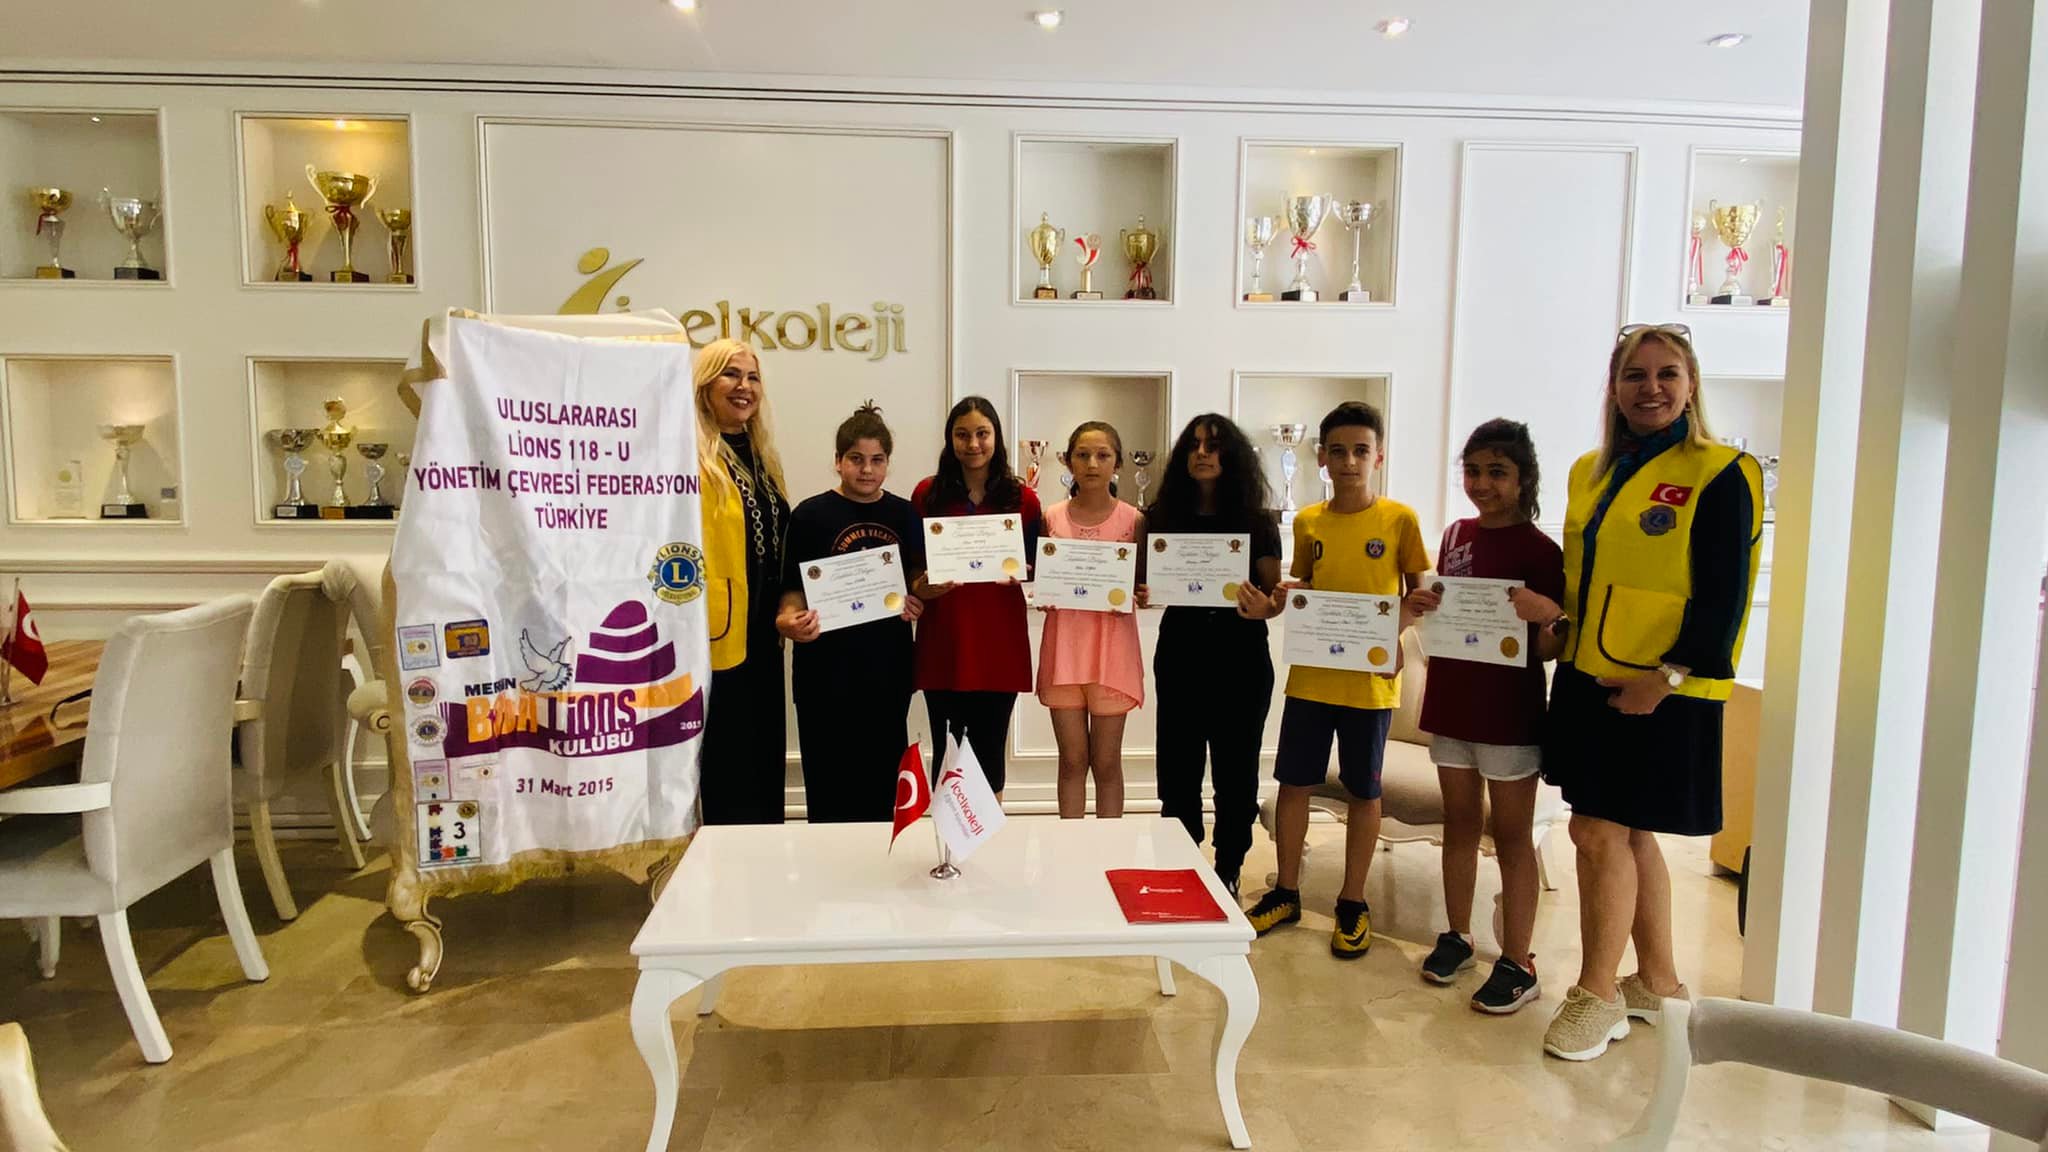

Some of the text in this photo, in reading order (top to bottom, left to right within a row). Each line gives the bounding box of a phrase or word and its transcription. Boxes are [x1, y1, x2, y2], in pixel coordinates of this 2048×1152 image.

[497, 397, 637, 428] ULUSLARARASI
[508, 430, 561, 460] LİONS
[569, 439, 598, 461] 118
[618, 441, 630, 461] U
[414, 461, 500, 491] YÖNETİM
[508, 468, 580, 498] ÇEVRESİ
[534, 503, 608, 530] TÜRKİYE
[660, 544, 699, 559] LIONS
[671, 561, 689, 584] L
[551, 728, 634, 756] KULÜBÜ
[516, 777, 614, 797] 31 Mart 2015
[453, 821, 466, 839] 3
